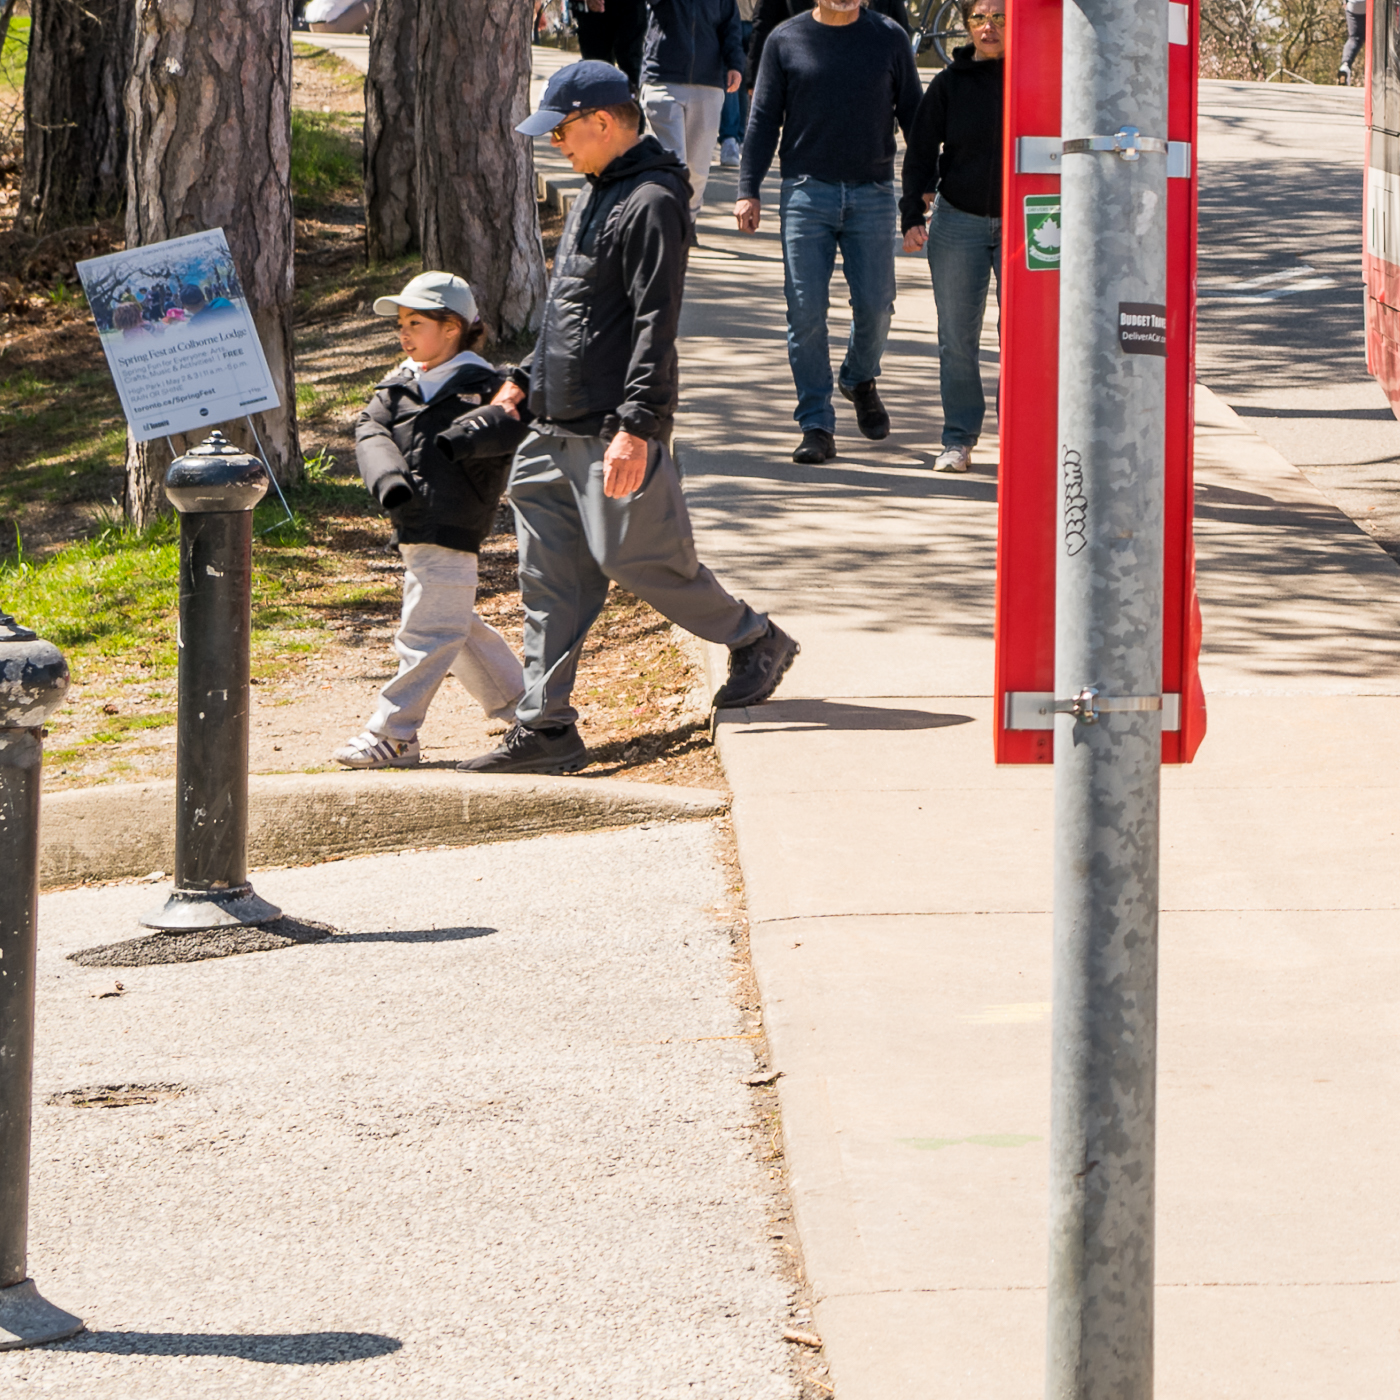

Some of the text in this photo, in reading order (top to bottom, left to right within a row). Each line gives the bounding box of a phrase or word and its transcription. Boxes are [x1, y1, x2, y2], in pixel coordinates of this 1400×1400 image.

[1120, 312, 1150, 327] BUDGET
[117, 326, 247, 368] Spring Fest at Colborne Lodge
[121, 365, 147, 378] Spring
[146, 361, 161, 370] Fun
[161, 358, 172, 366] for
[149, 366, 171, 377] Music
[222, 348, 244, 359] FREE
[127, 385, 145, 395] High
[145, 381, 161, 390] Park
[165, 376, 181, 386] May
[133, 387, 216, 414] toronto.ca/SpringFest
